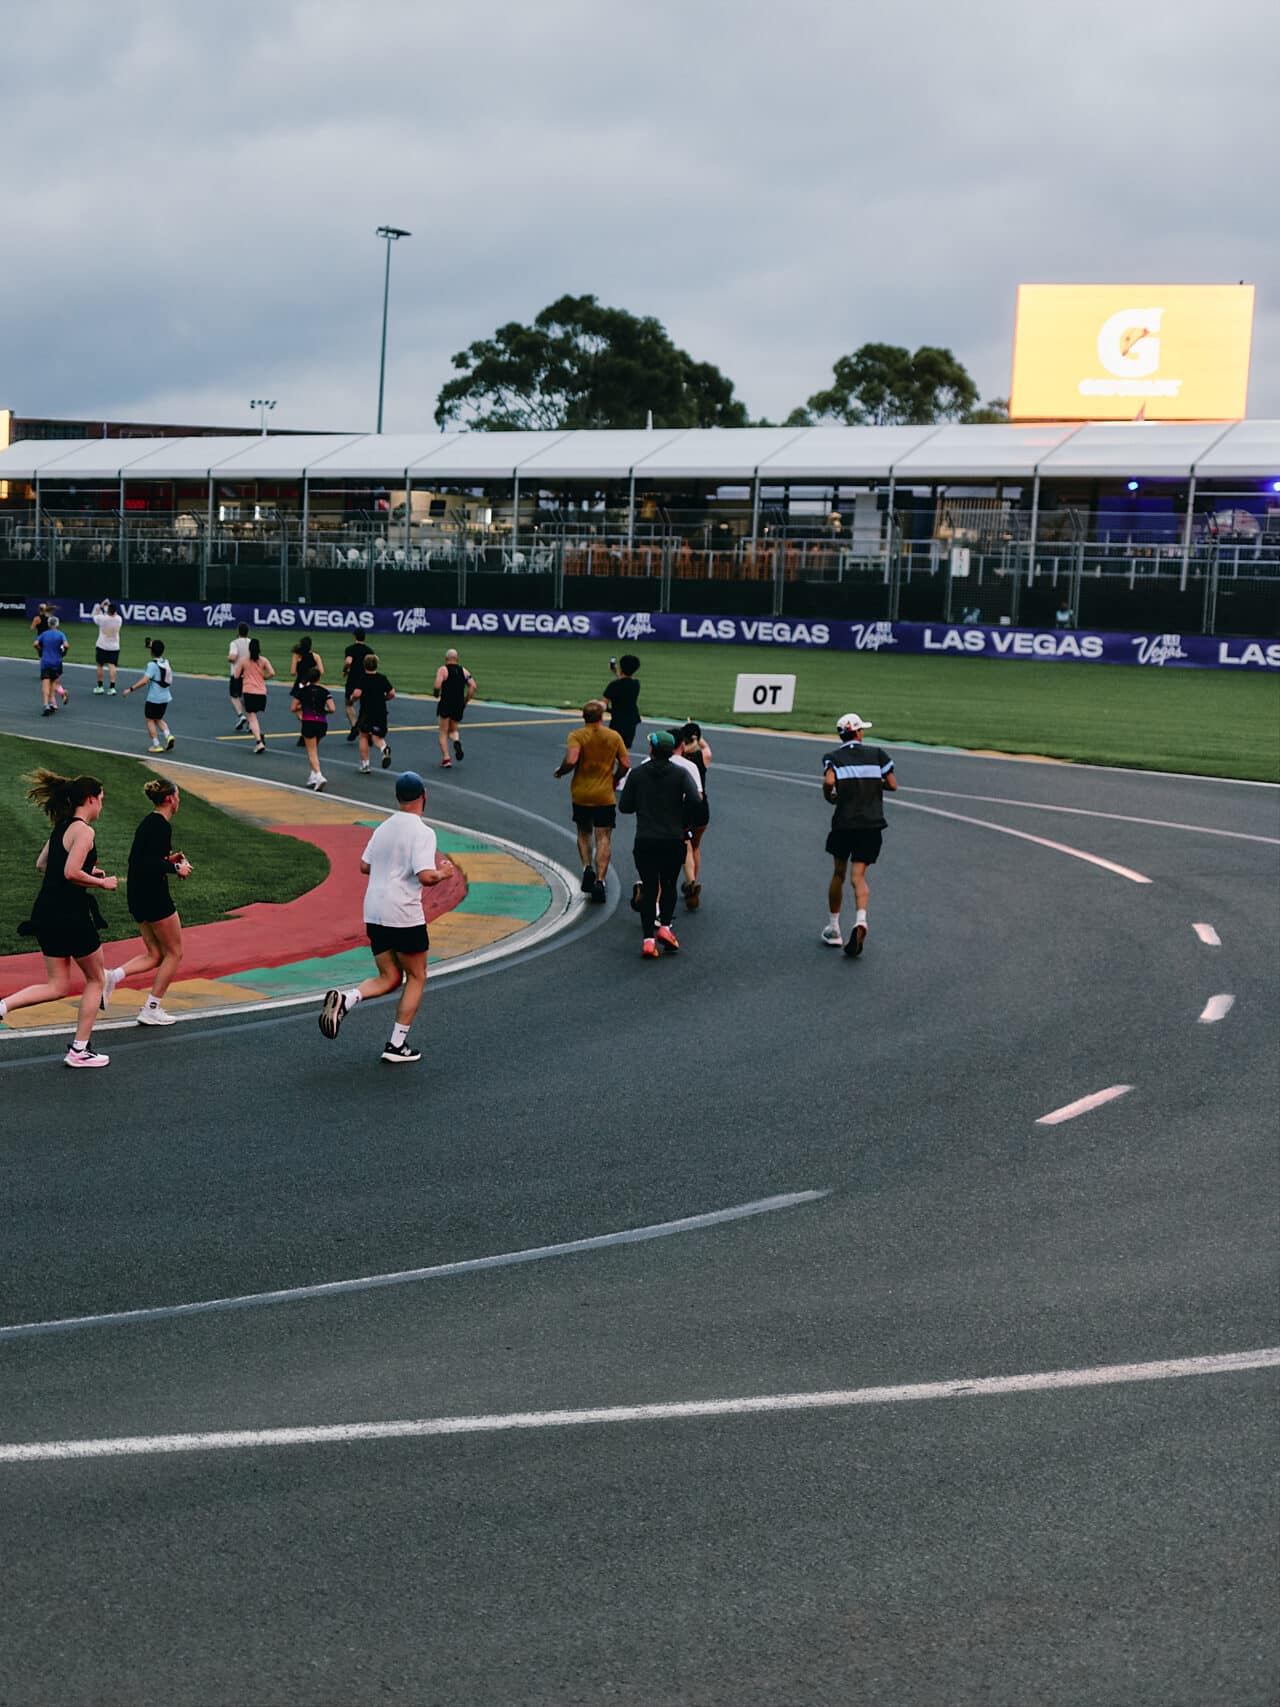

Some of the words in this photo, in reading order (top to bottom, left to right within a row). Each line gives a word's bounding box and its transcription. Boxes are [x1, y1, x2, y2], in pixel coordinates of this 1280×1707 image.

[1097, 308, 1166, 378] G
[120, 604, 187, 622] VEGAS
[254, 608, 295, 625] LAS
[299, 609, 374, 628] VEGAS
[451, 613, 498, 631] LAS
[503, 614, 590, 634] VEGAS
[680, 619, 736, 639] LAS
[740, 620, 829, 643] VEGAS
[924, 629, 985, 651] LAS
[991, 631, 1103, 658] VEGAS
[753, 685, 782, 705] OT
